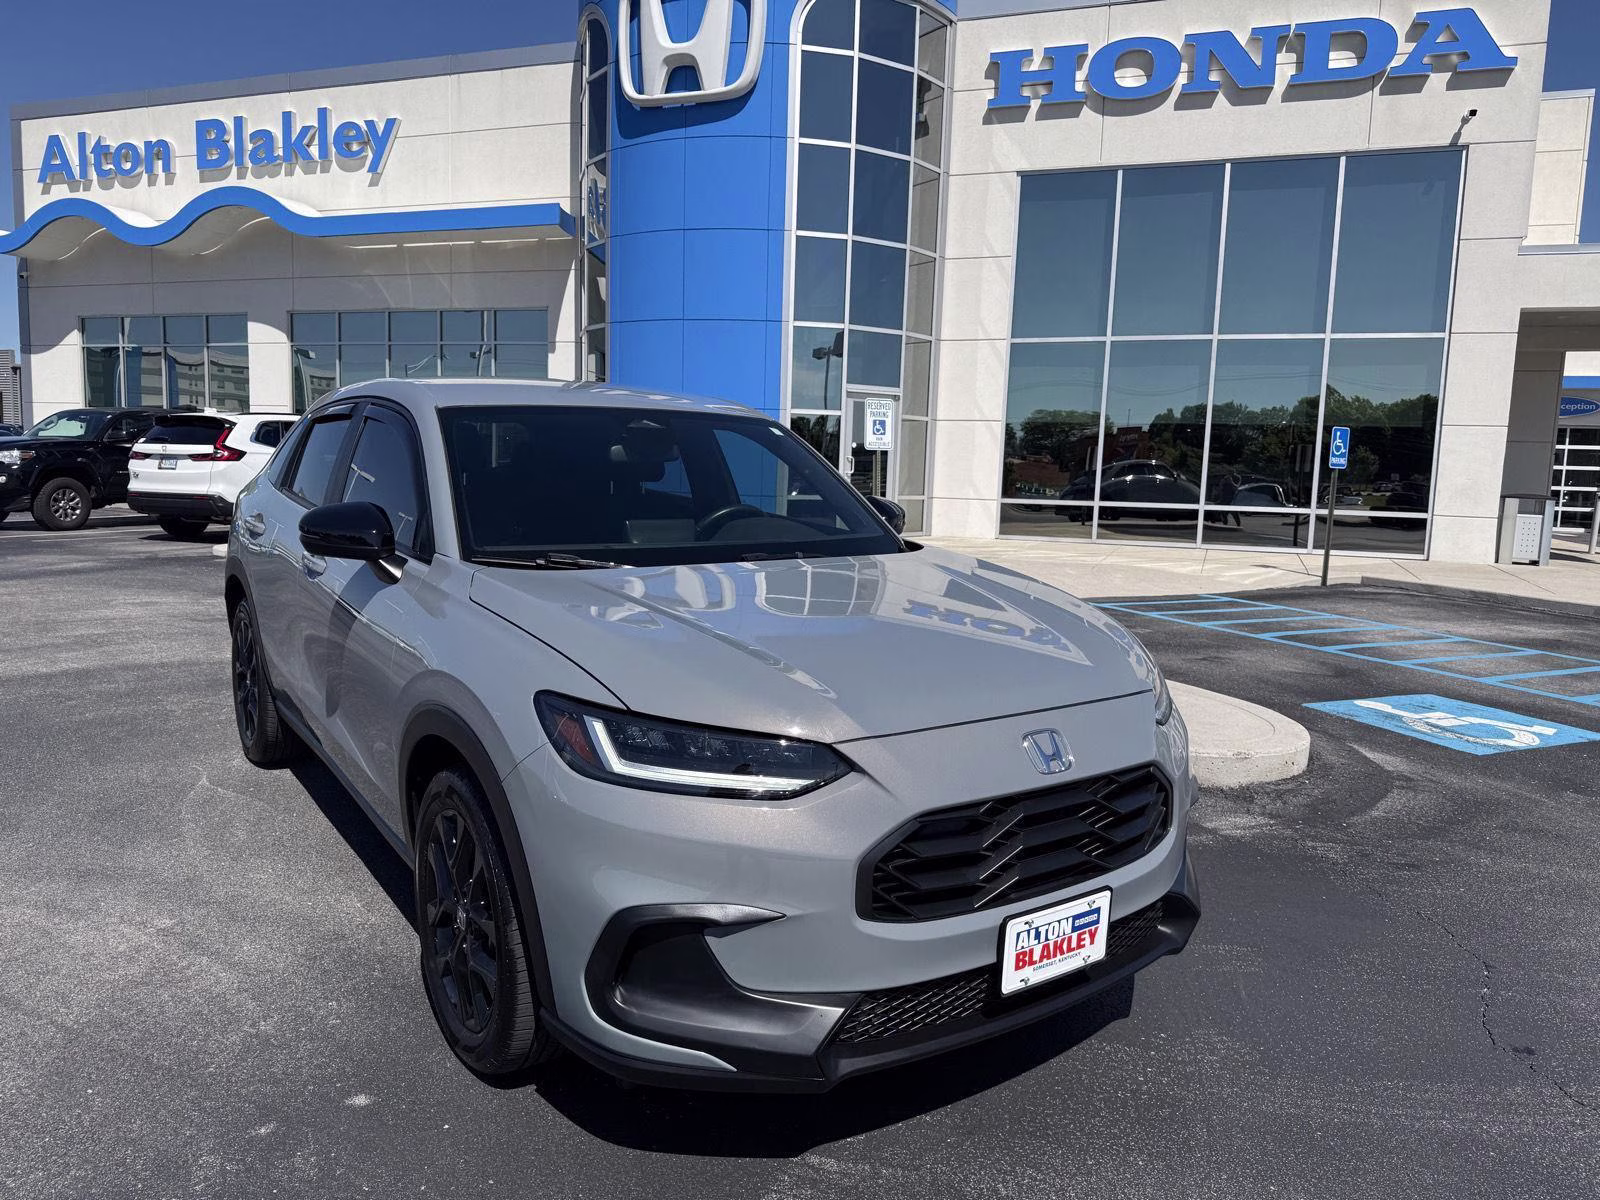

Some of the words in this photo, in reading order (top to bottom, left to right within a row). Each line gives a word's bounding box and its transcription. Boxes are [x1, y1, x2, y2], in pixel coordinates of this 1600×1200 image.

[987, 7, 1518, 109] HONDA
[39, 132, 171, 183] Alton
[196, 107, 398, 174] Blakley
[868, 402, 891, 410] RESERVED
[869, 410, 889, 418] PARKING
[1014, 926, 1099, 971] BLAKLEY
[1015, 916, 1073, 951] ALTON
